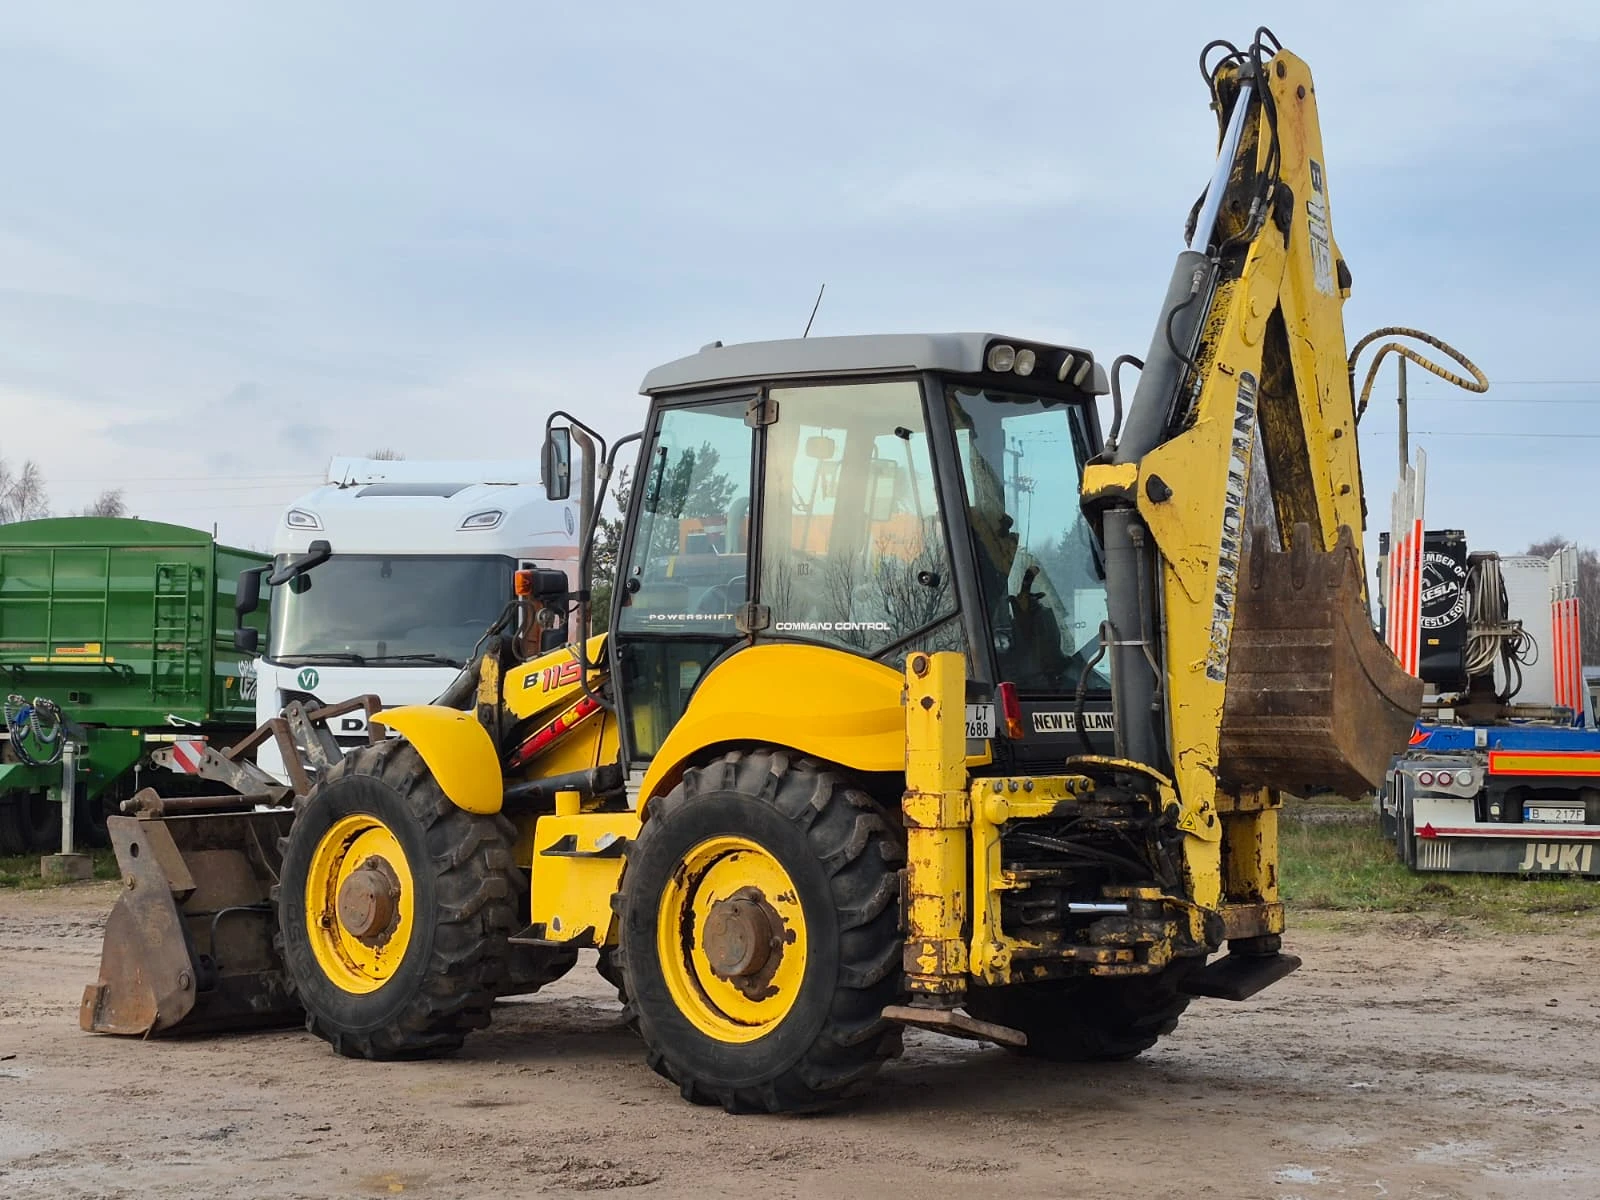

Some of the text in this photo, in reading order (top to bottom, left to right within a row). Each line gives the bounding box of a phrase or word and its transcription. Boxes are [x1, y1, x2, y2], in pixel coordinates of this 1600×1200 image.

[1423, 553, 1466, 578] EMBER OF
[648, 613, 734, 621] POWERSHIFT
[775, 622, 891, 631] COMMAND CONTROL
[301, 671, 316, 687] VI
[975, 705, 988, 720] LT
[1034, 714, 1114, 730] NEW HLLAN
[1519, 843, 1593, 872] JYKI
